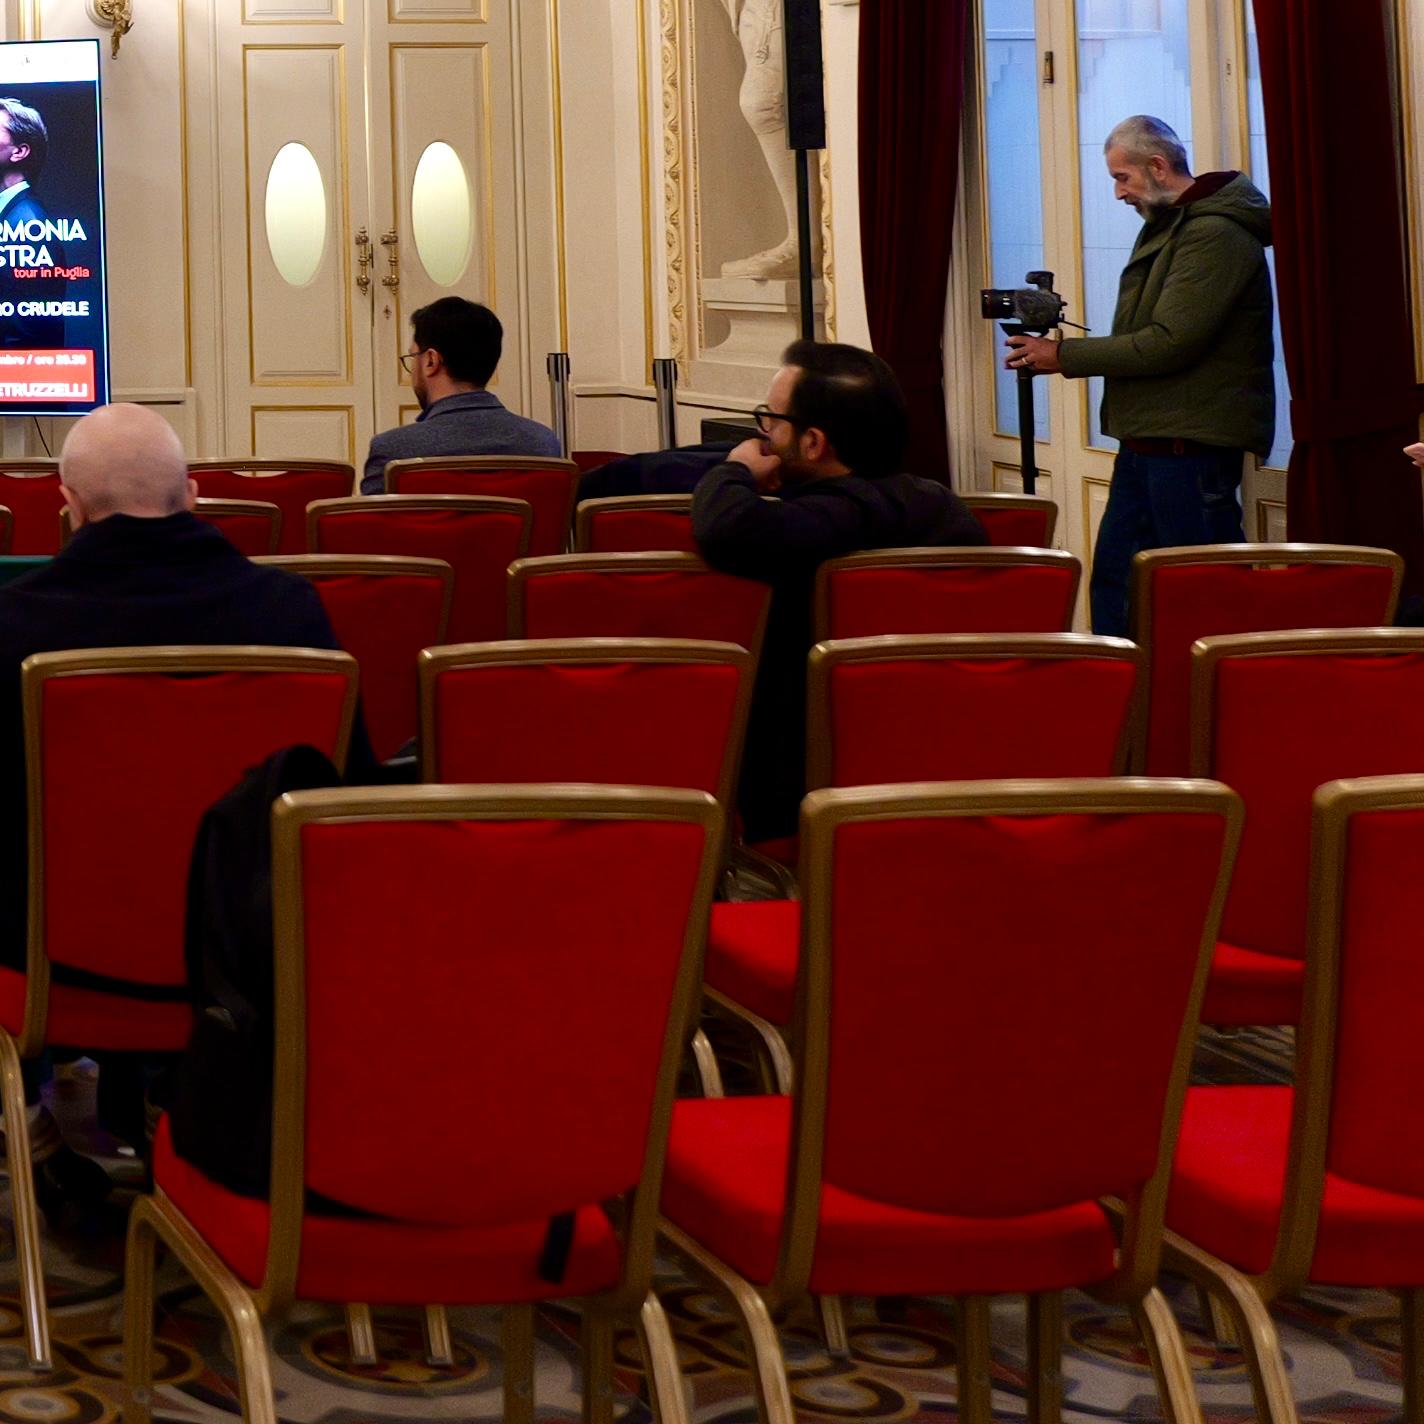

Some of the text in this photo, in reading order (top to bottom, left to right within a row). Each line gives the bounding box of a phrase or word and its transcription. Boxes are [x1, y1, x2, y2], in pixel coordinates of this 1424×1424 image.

[14, 267, 89, 280] tour in Puglia
[17, 301, 89, 316] CRUDELE
